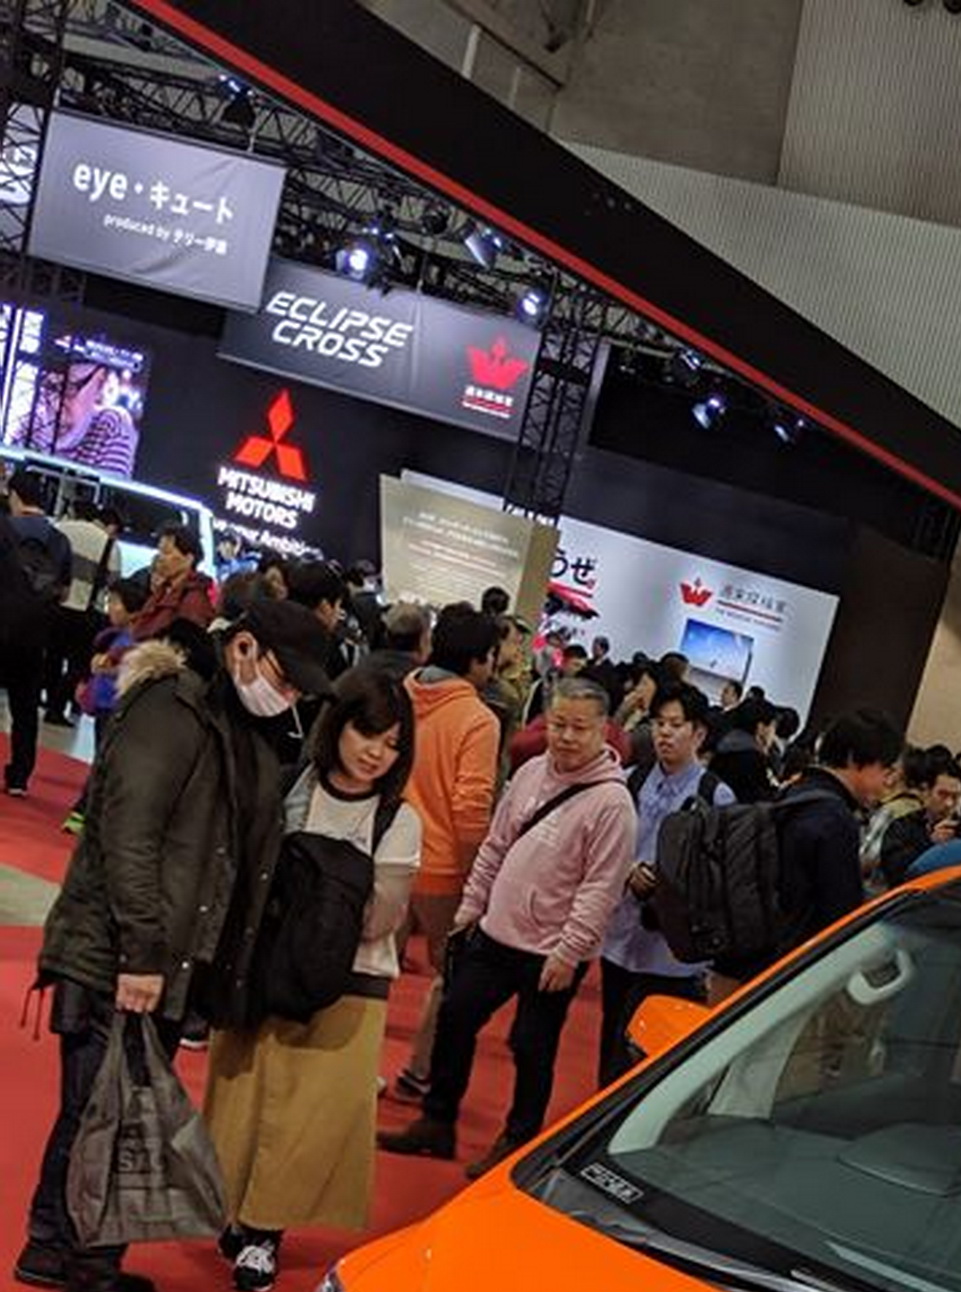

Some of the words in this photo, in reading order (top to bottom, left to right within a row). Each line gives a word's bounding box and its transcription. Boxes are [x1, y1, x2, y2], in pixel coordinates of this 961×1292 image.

[265, 291, 414, 347] ECLIPSE
[272, 320, 389, 367] CROSS
[217, 466, 316, 512] MITSUBISHI
[225, 491, 298, 529] MOTORS
